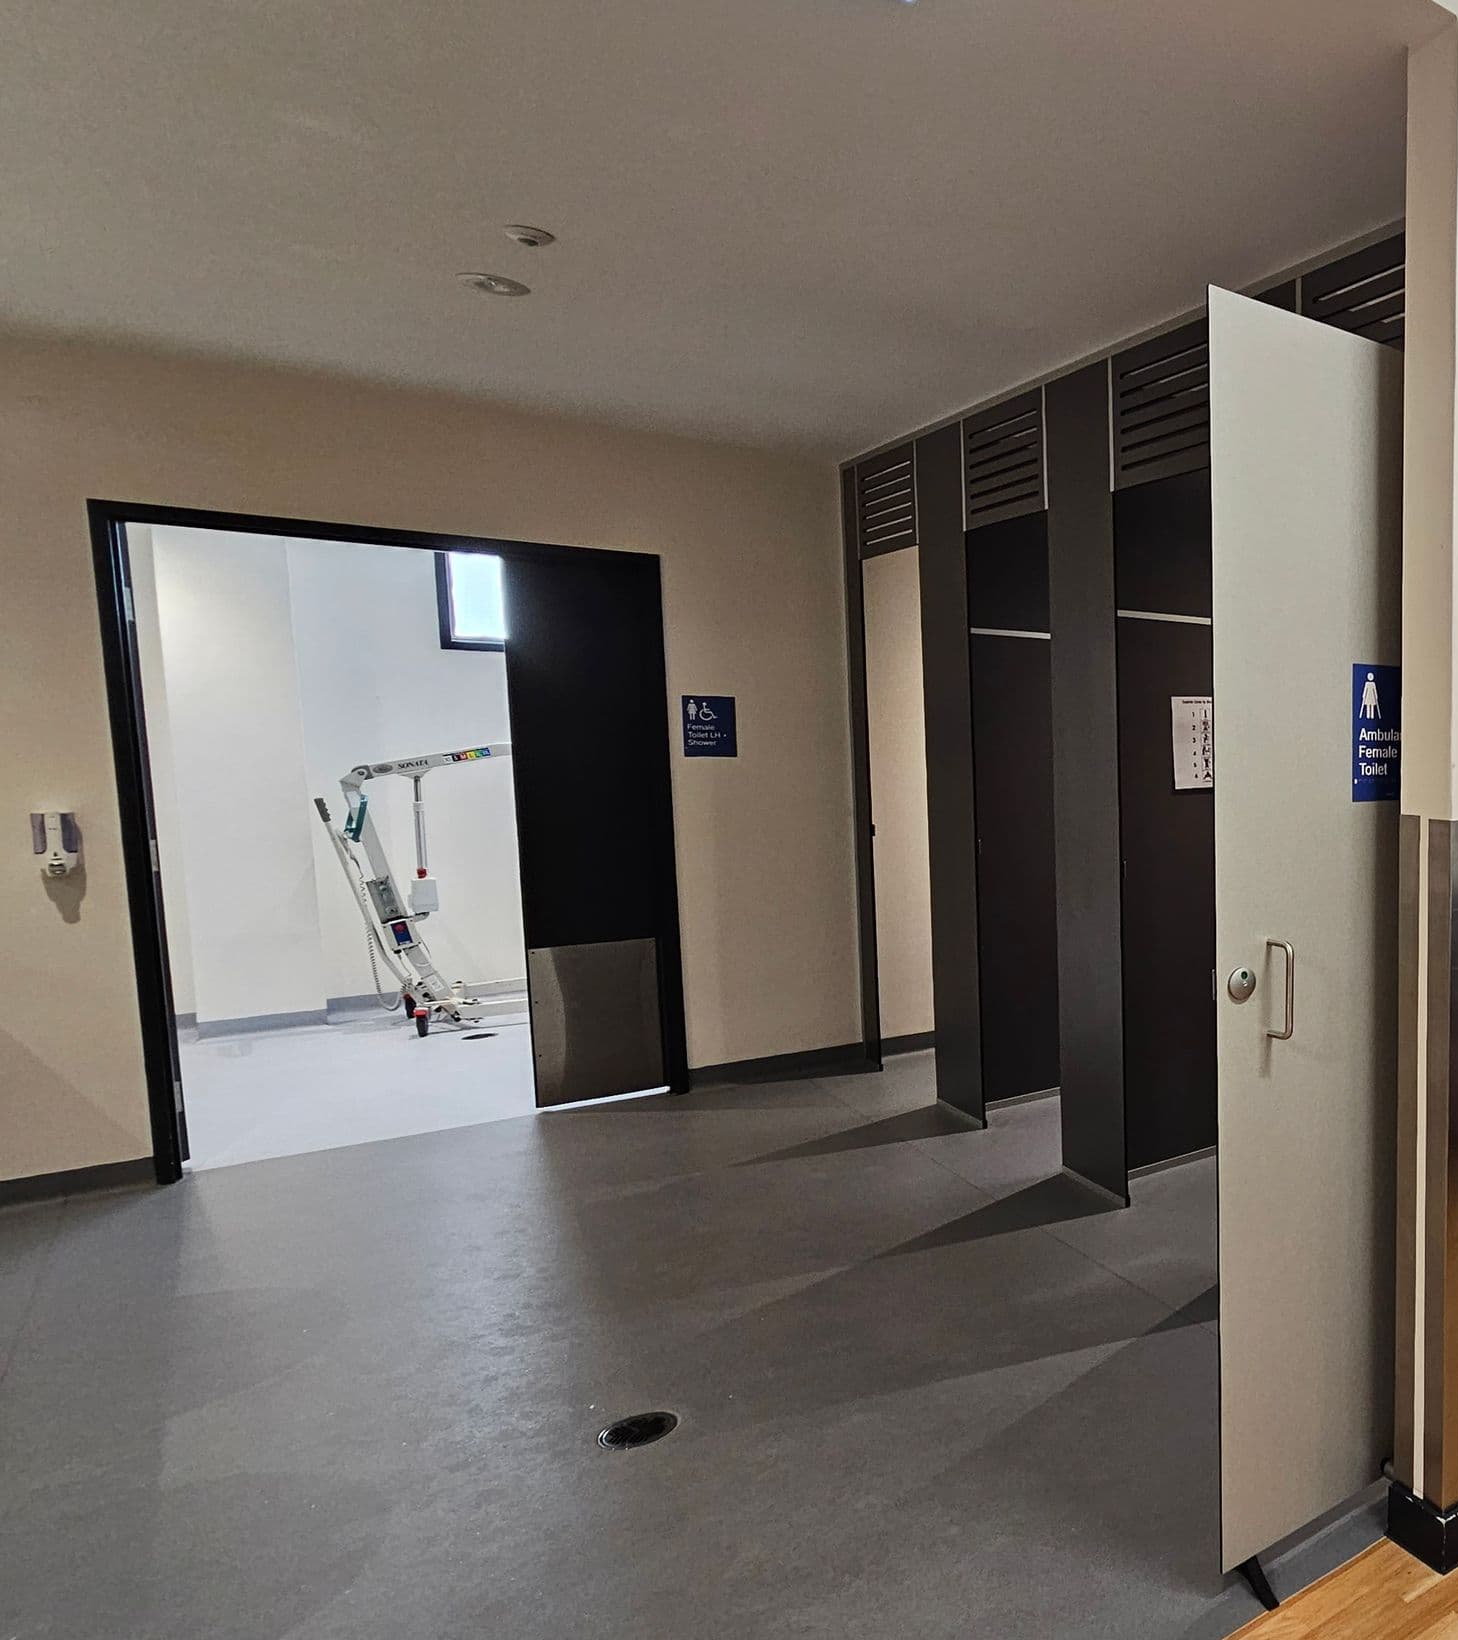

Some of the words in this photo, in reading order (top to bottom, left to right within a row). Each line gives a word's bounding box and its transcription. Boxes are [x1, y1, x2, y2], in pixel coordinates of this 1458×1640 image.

[1359, 728, 1402, 742] Ambula
[1358, 745, 1398, 759] Female
[397, 759, 429, 770] SONATA
[1358, 762, 1388, 776] Toilet
